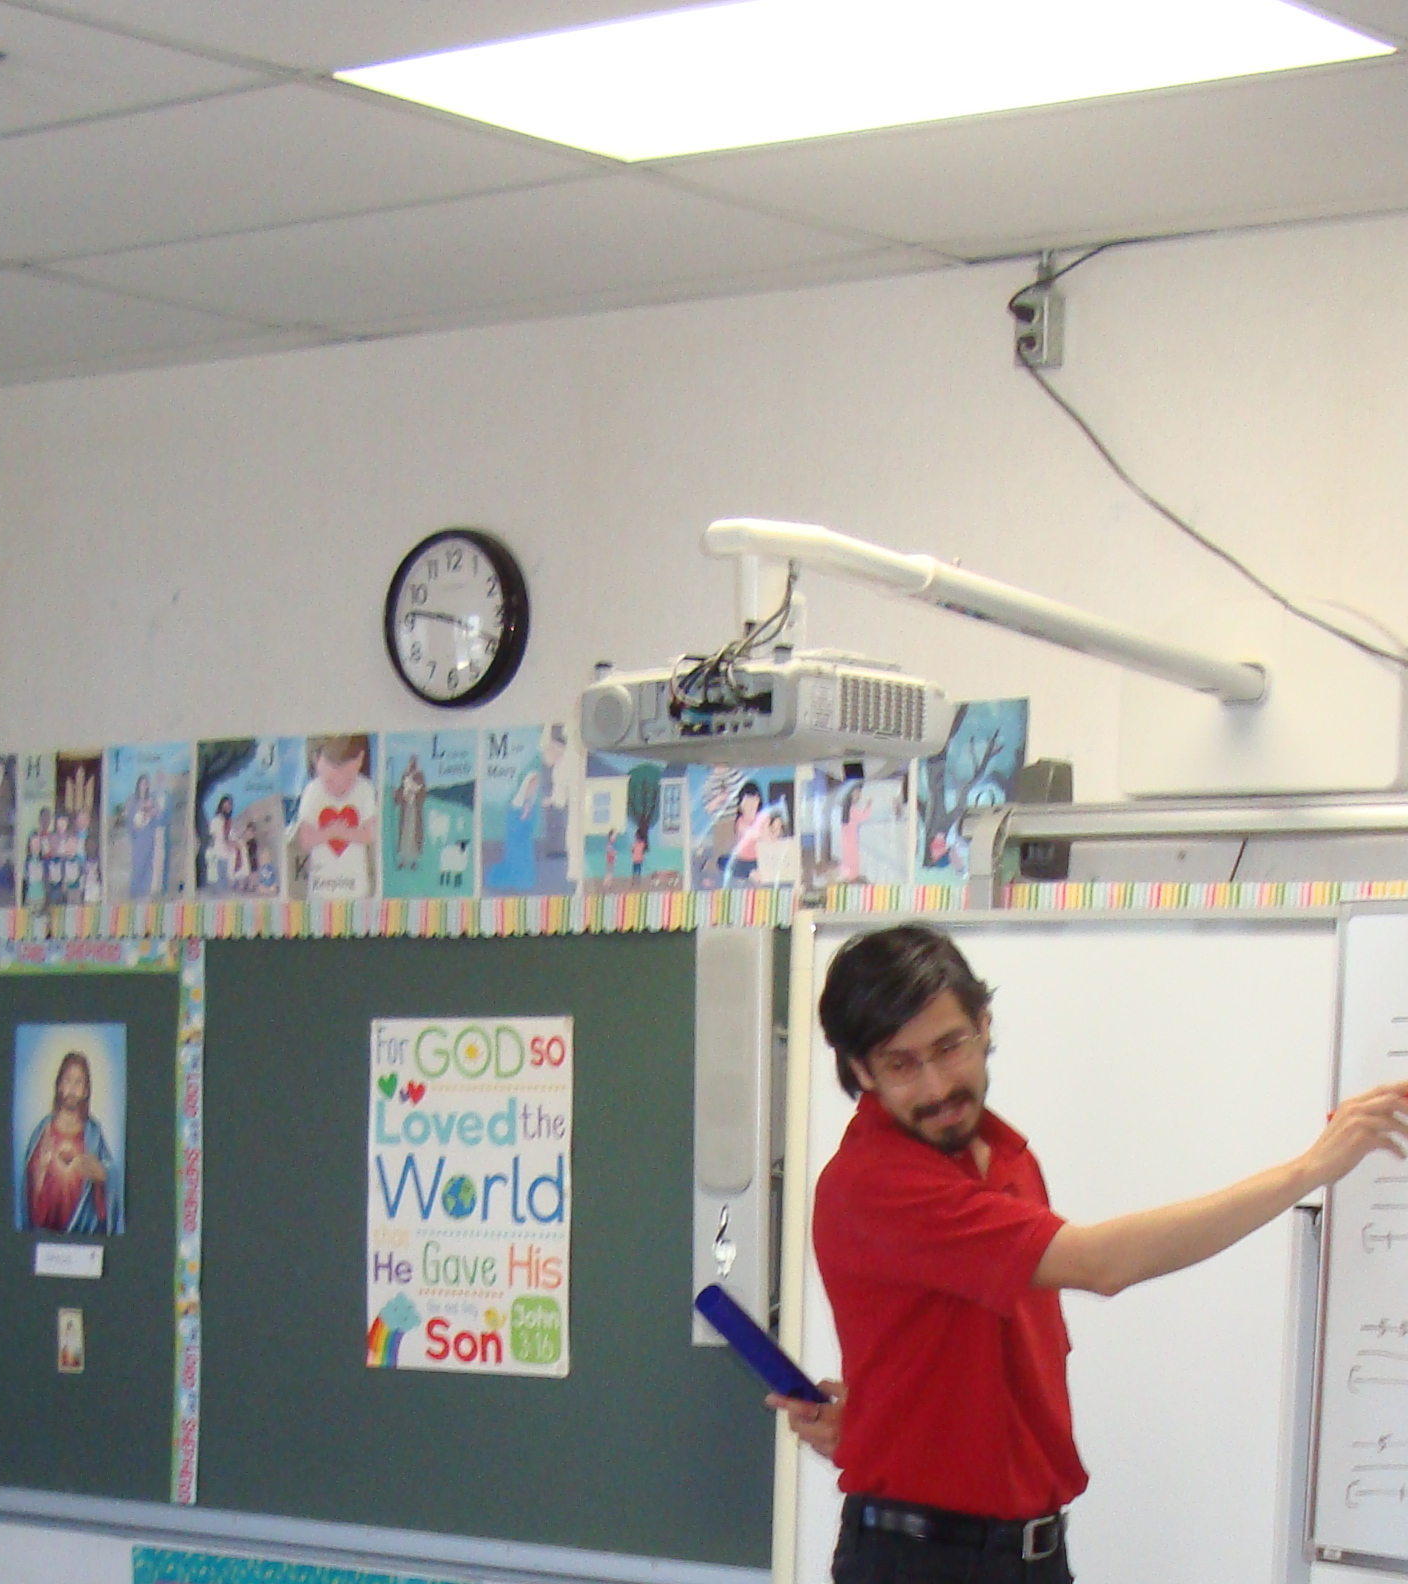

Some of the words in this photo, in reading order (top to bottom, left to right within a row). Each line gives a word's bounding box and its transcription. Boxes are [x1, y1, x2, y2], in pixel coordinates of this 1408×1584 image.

[426, 559, 440, 582] 11
[445, 549, 463, 573] 12
[472, 555, 479, 578] 1
[409, 583, 428, 606] 10
[426, 660, 437, 681] 7
[447, 667, 460, 690] 6
[488, 732, 508, 760] M
[375, 1025, 410, 1065] For
[414, 1024, 525, 1079] GOD
[375, 1097, 518, 1147] Loved
[520, 1102, 566, 1141] the
[375, 1152, 565, 1225] World
[373, 1251, 413, 1285] He
[422, 1240, 497, 1287] Gave
[507, 1243, 563, 1290] His
[512, 1304, 560, 1331] John
[425, 1316, 503, 1365] Son
